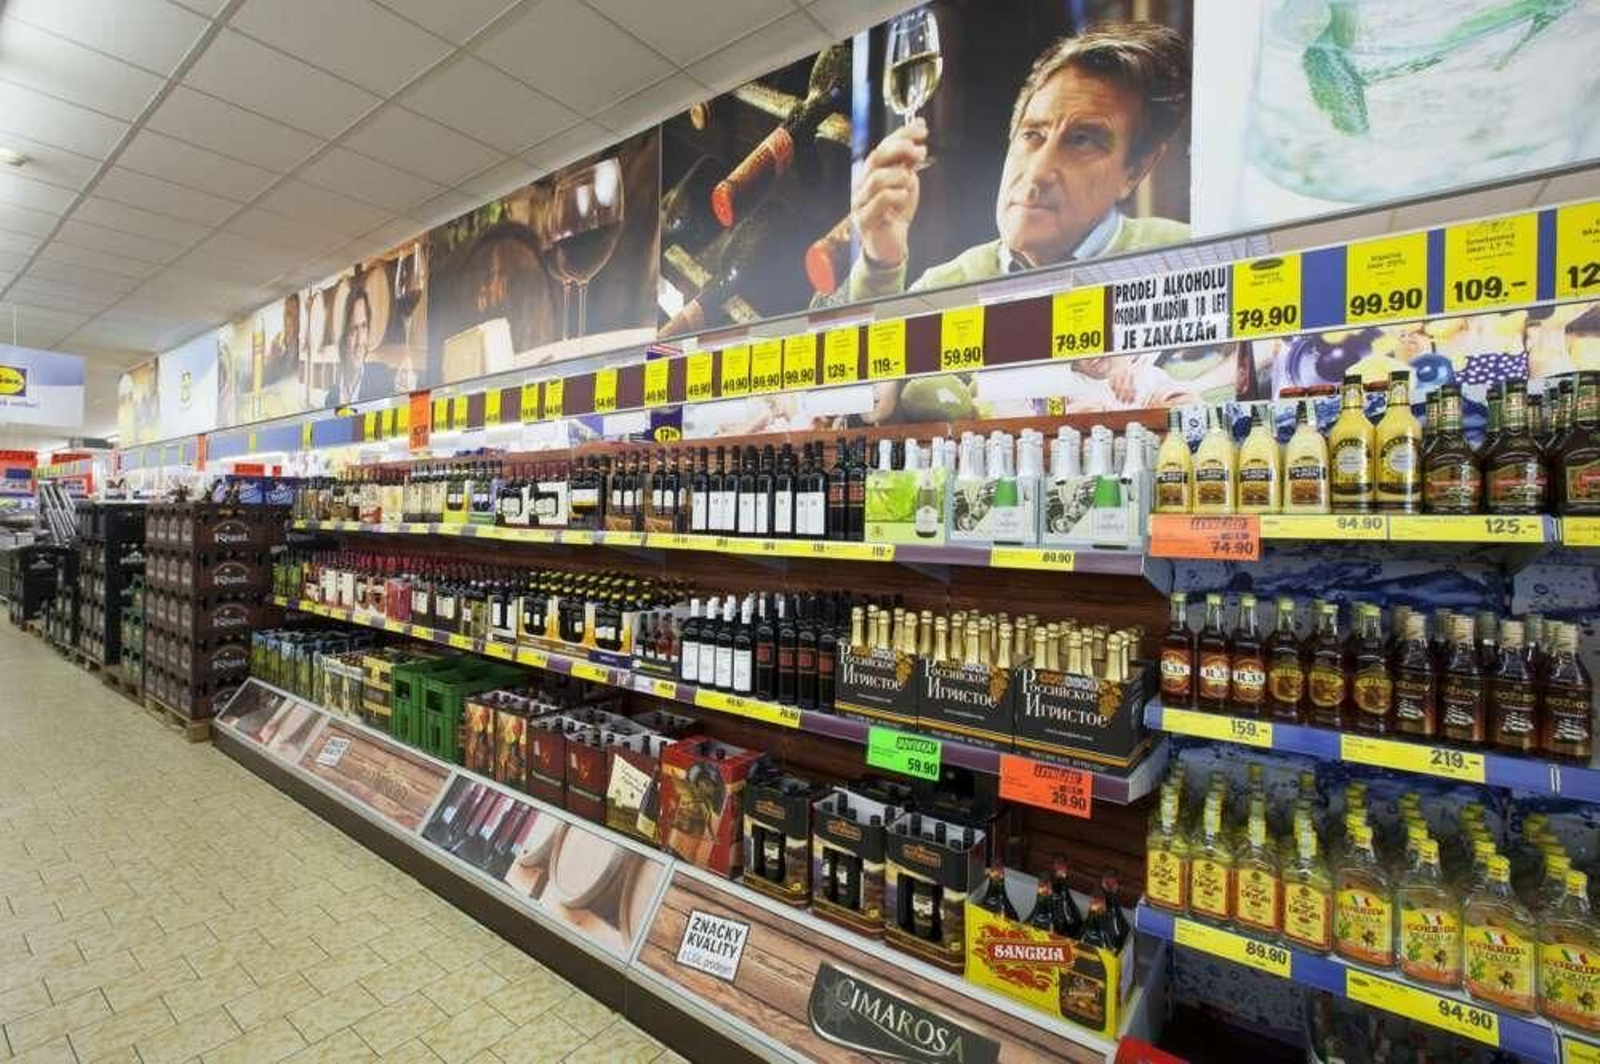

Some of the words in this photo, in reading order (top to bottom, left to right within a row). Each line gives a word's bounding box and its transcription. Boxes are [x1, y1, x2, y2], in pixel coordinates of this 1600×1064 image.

[1115, 277, 1157, 303] PRODEJ
[1163, 267, 1226, 296] ALKOHOLU
[1454, 276, 1527, 303] 109.-
[1195, 295, 1206, 317] 18
[1212, 293, 1226, 314] LET
[1350, 288, 1423, 317] 99.90
[1236, 304, 1297, 330] 79.90
[1055, 330, 1101, 352] 79.90
[1122, 330, 1137, 350] JE
[873, 357, 900, 373] 119.-
[944, 346, 981, 366] 59.90
[785, 368, 815, 385] 99.90
[1336, 516, 1383, 530] 94.90
[1484, 518, 1538, 536] 125.-
[1210, 540, 1254, 555] 74.90
[1229, 717, 1268, 738] 159.-
[907, 756, 938, 776] 59.90
[1430, 749, 1481, 770] 219.-
[1051, 790, 1087, 811] 29.90
[687, 932, 738, 959] KVALITY
[993, 943, 1066, 962] SANGRIA
[1245, 941, 1288, 966] 89.90
[834, 978, 965, 1064] CIMAROSA
[1437, 999, 1493, 1031] 94.90
